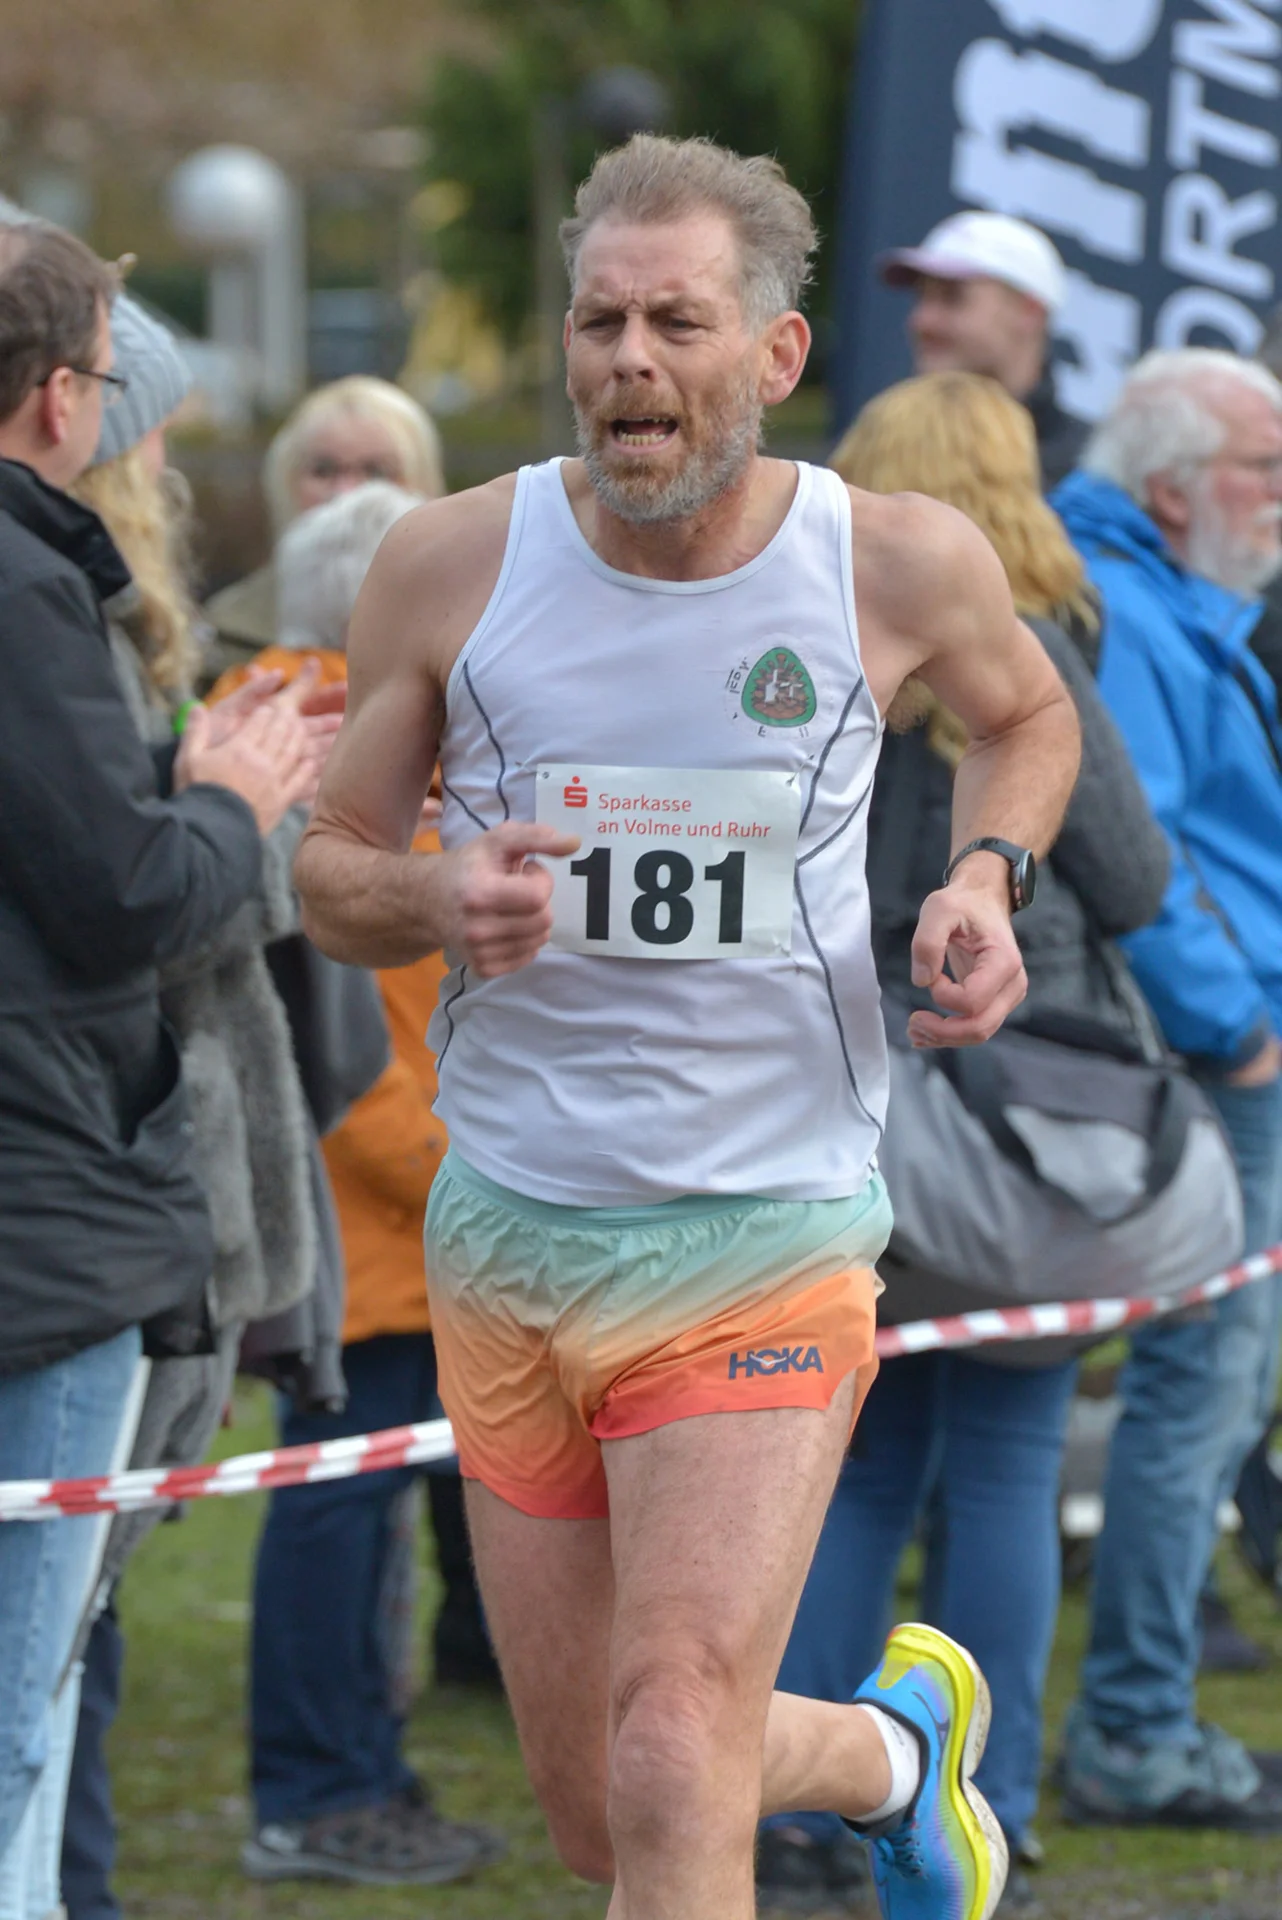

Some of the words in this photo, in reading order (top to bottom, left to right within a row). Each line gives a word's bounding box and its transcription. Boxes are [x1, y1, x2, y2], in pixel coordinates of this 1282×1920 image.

[598, 793, 692, 812] Sparkasse
[597, 820, 619, 834] an
[624, 819, 682, 836] Volme
[687, 820, 722, 838] und
[727, 822, 771, 838] Ruhr
[570, 847, 746, 945] 181
[729, 1346, 824, 1380] HOKA
